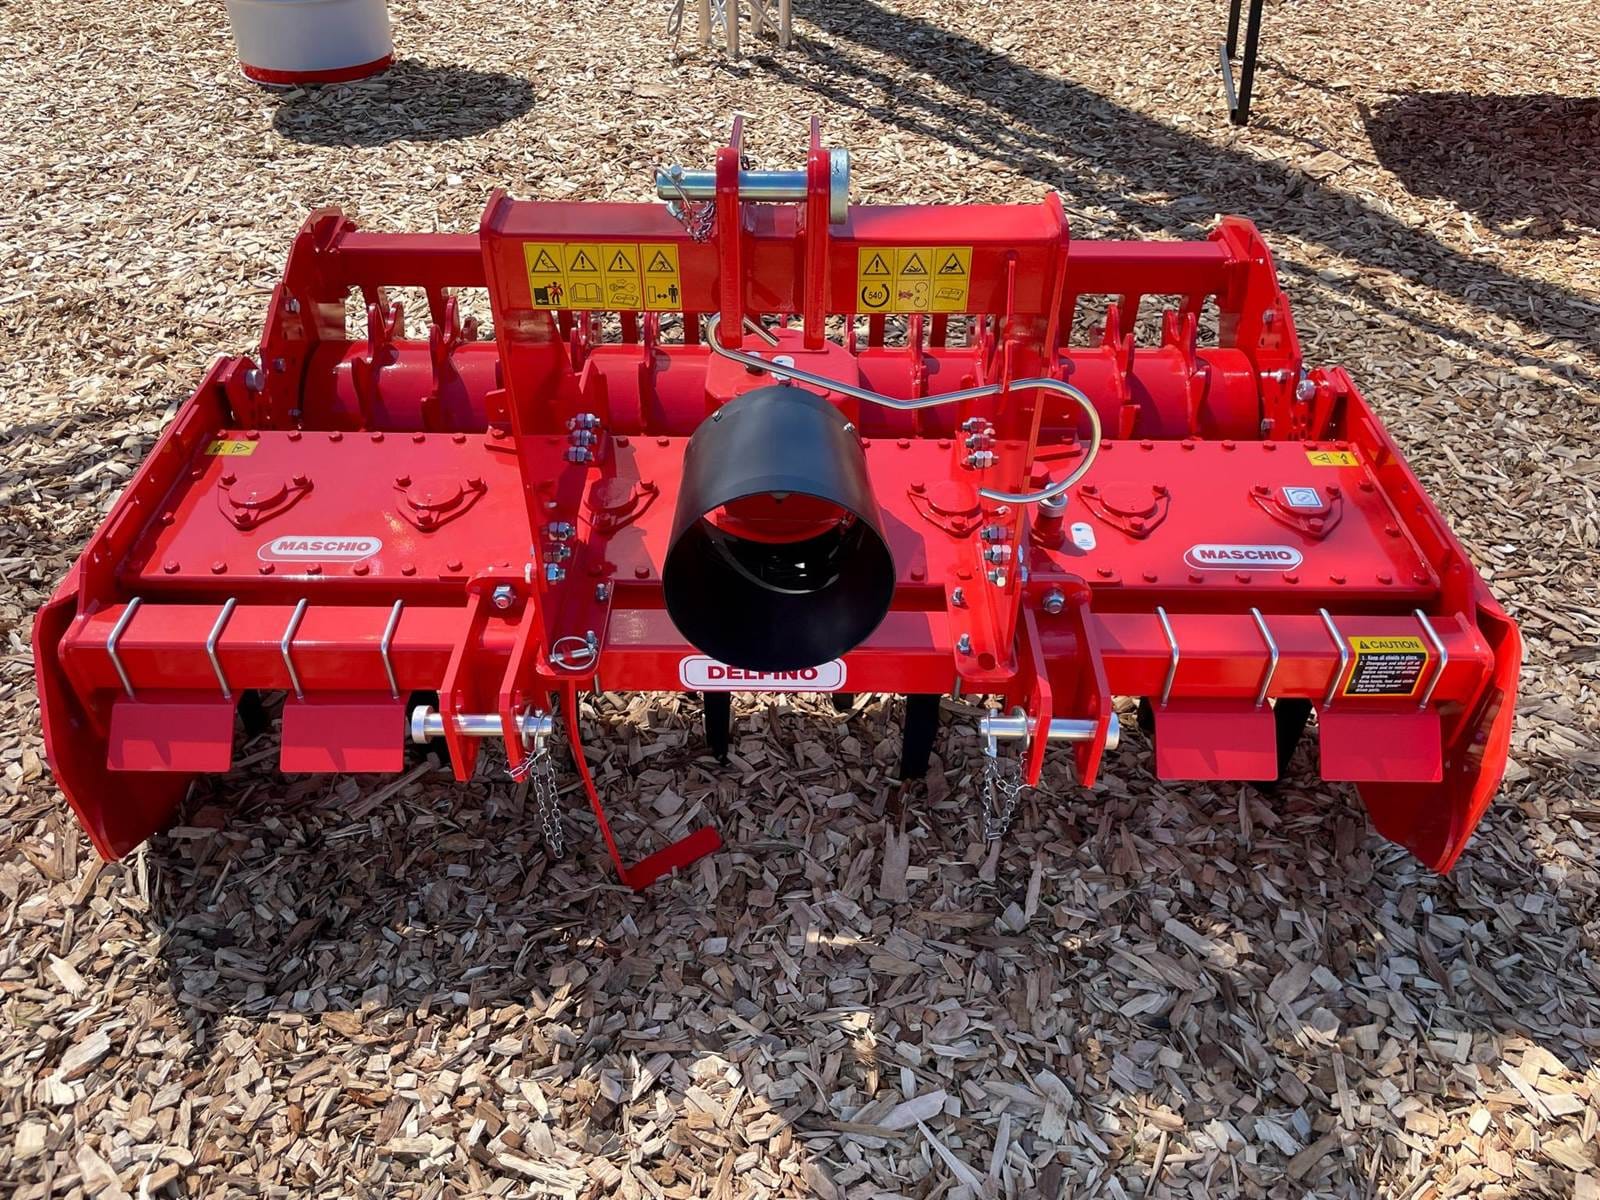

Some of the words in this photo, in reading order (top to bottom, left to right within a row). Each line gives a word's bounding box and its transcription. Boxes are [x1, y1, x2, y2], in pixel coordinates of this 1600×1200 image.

[868, 291, 882, 299] 540
[278, 541, 372, 551] MASCHIO
[1199, 550, 1292, 560] MASCHIO
[1370, 640, 1419, 649] CAUTION
[707, 665, 819, 681] DELFINO
